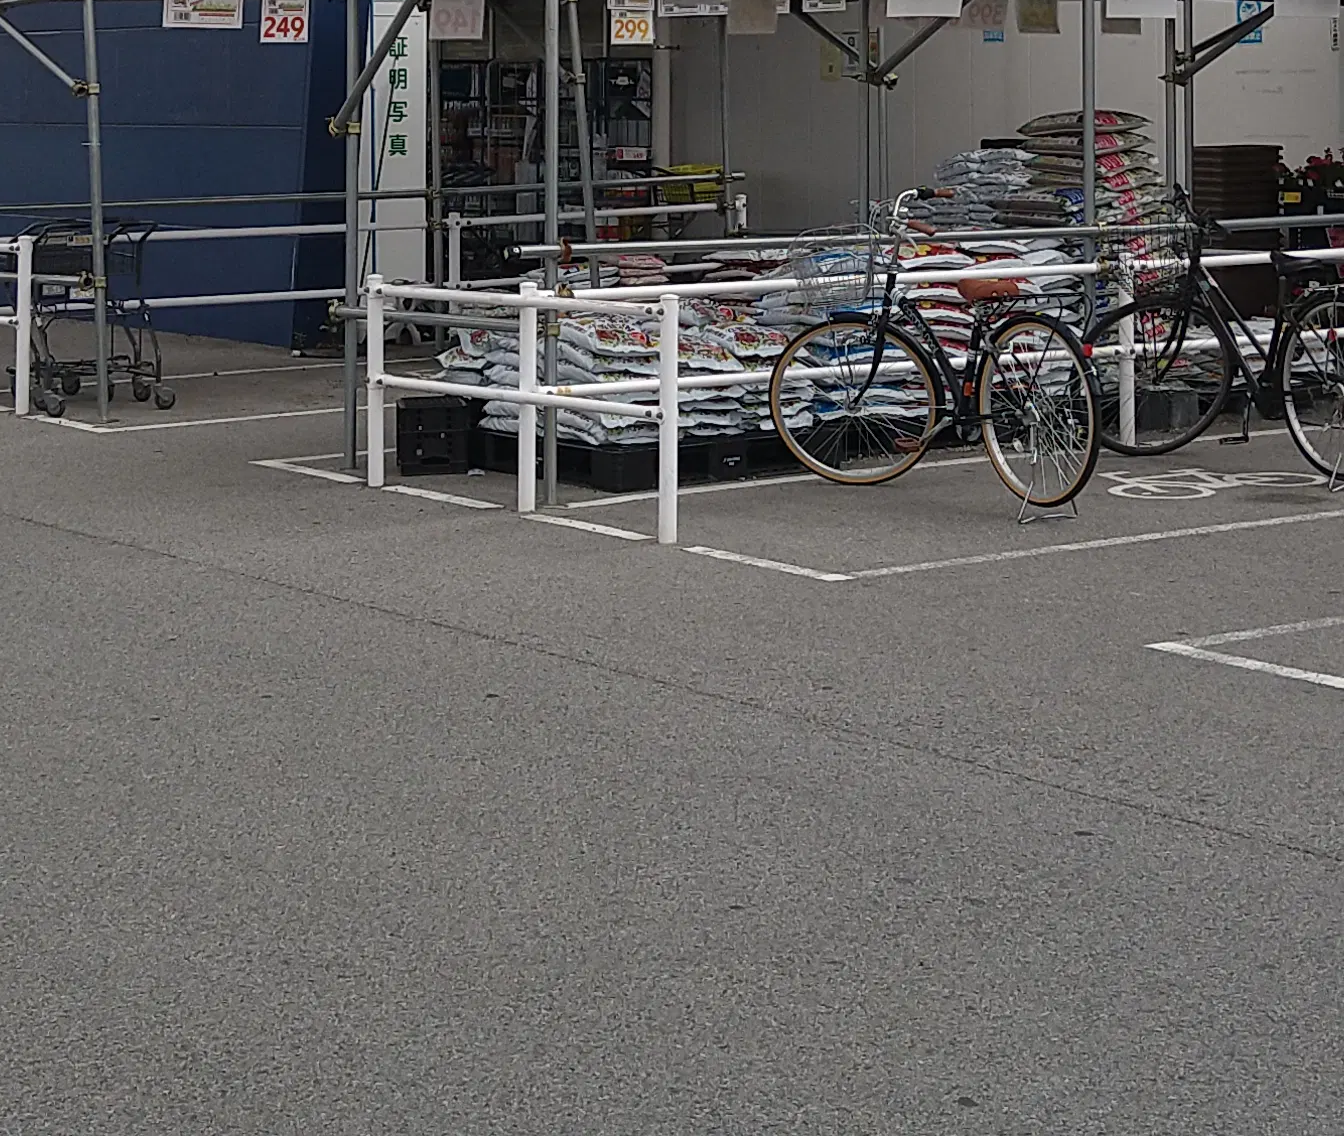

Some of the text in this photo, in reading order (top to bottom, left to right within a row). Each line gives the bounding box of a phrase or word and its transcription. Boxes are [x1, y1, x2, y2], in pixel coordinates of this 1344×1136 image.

[263, 16, 305, 39] 249
[614, 19, 649, 40] 299
[388, 36, 408, 156] 証明写真
